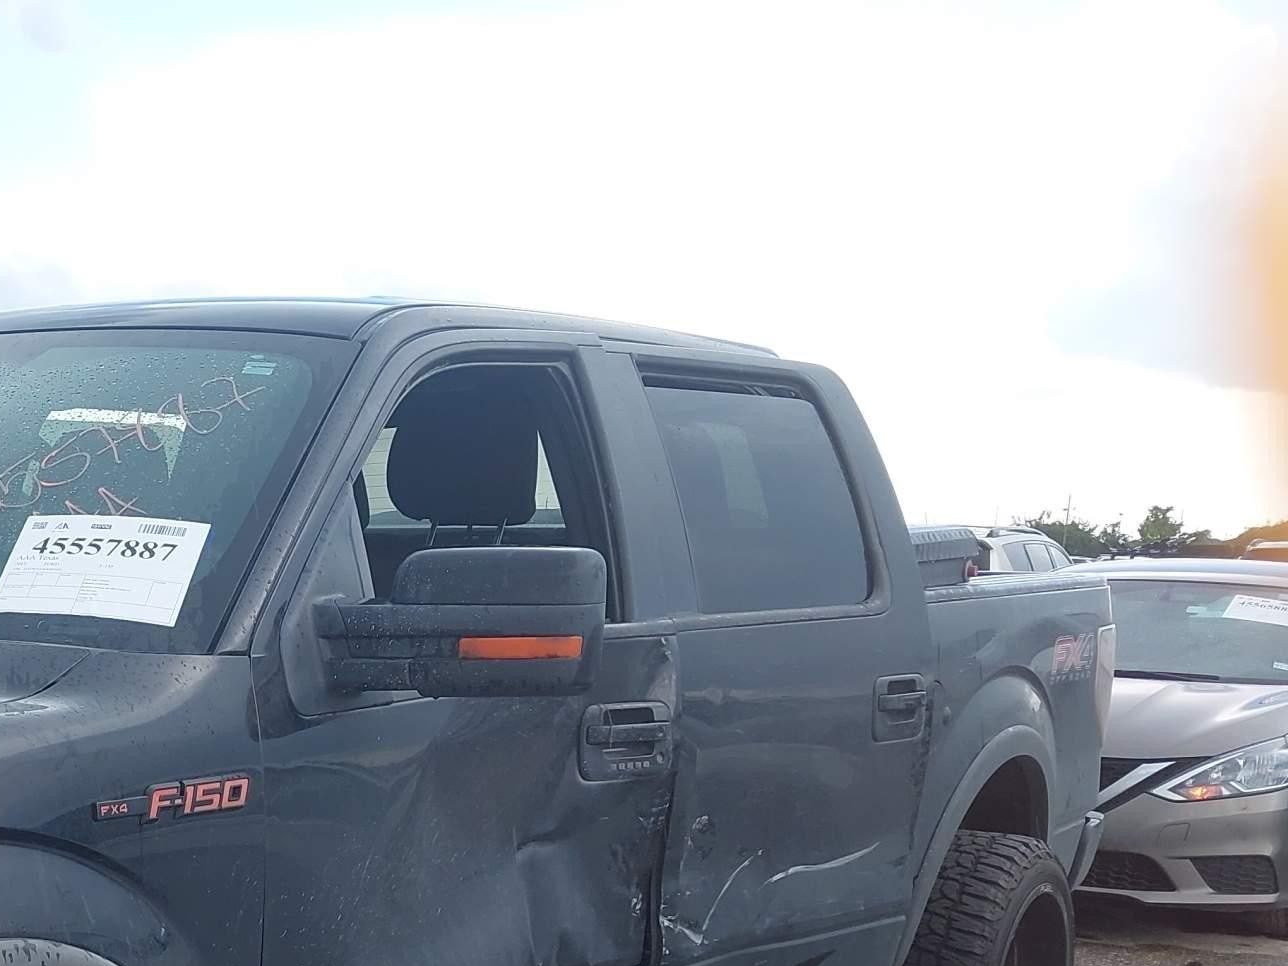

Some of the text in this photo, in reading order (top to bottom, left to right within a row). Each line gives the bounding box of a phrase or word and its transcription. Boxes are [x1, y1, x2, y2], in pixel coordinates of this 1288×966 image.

[31, 536, 179, 562] 45557887
[1051, 632, 1097, 673] FX4
[100, 776, 250, 820] FX4 F-150
